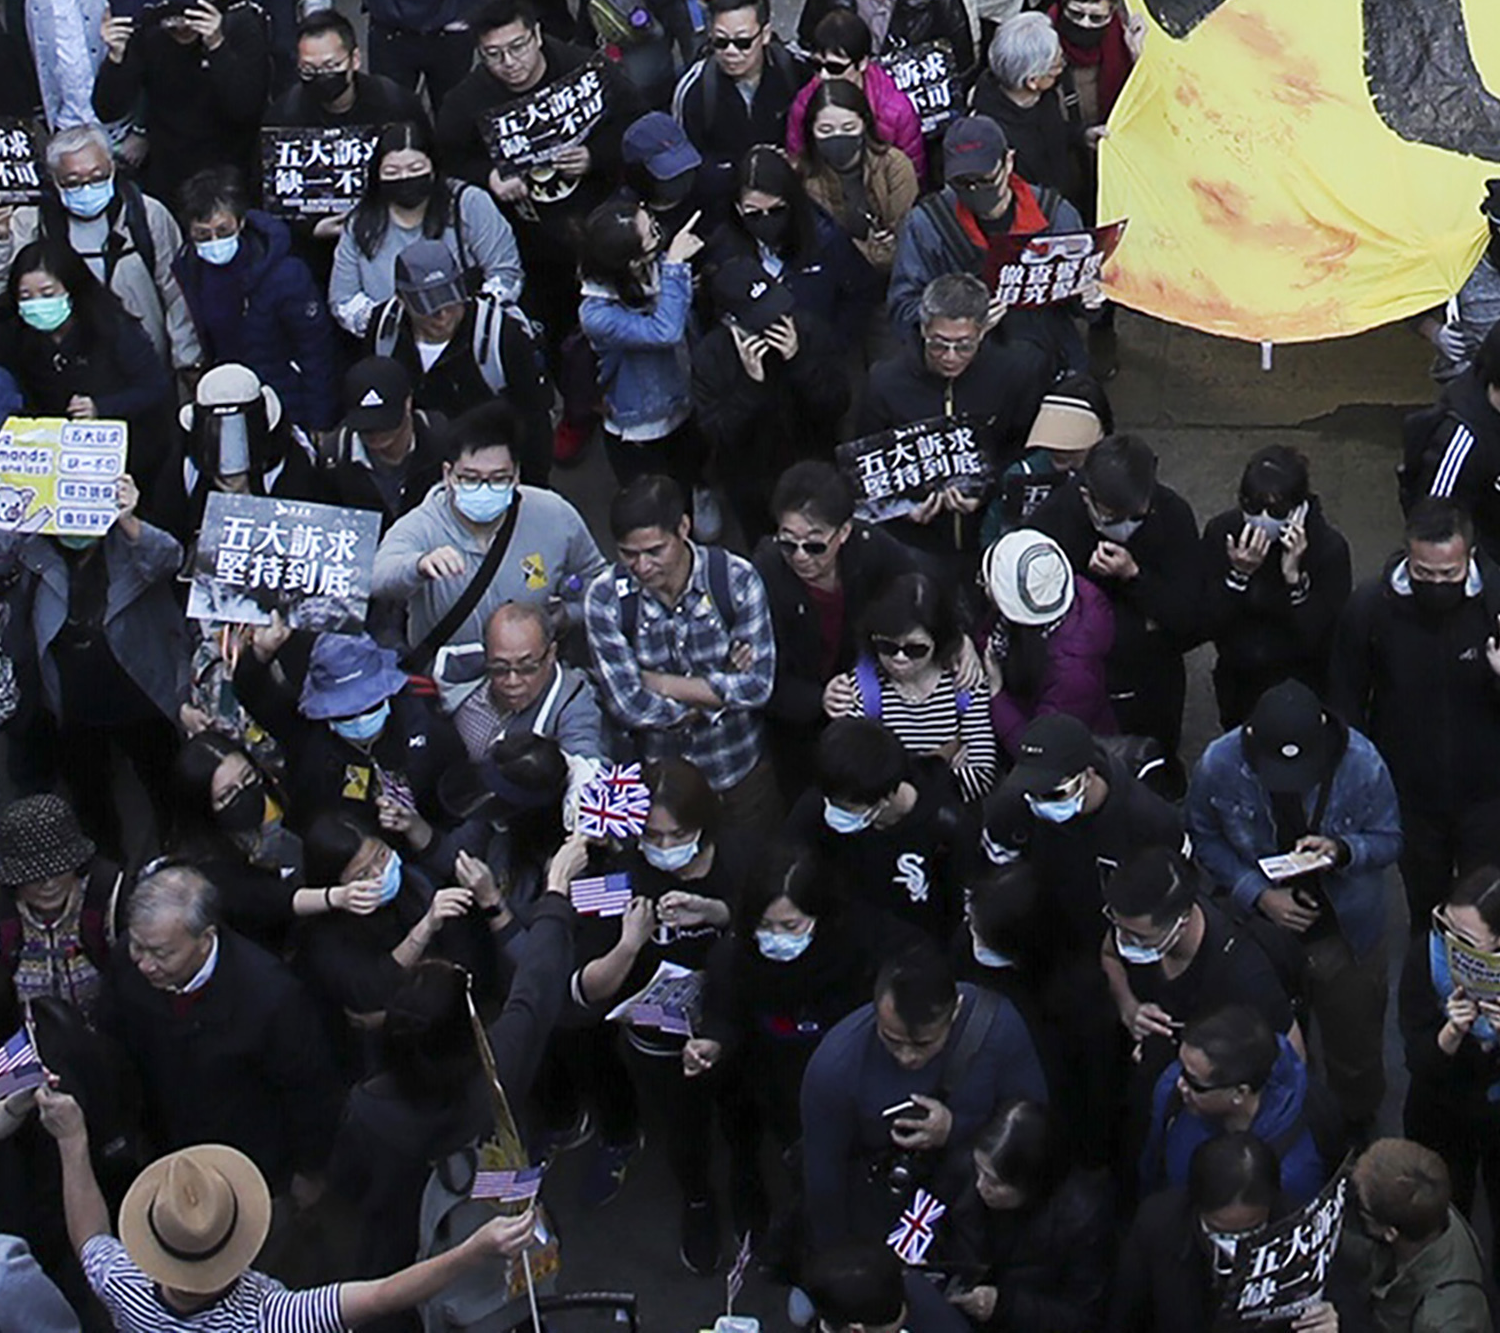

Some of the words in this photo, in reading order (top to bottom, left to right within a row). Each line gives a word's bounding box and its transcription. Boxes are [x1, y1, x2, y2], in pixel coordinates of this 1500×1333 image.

[854, 428, 979, 476] 五大訴求
[860, 449, 985, 501] 堅持到底
[222, 515, 360, 561] 五大訴求
[214, 548, 353, 597] 堅持到底
